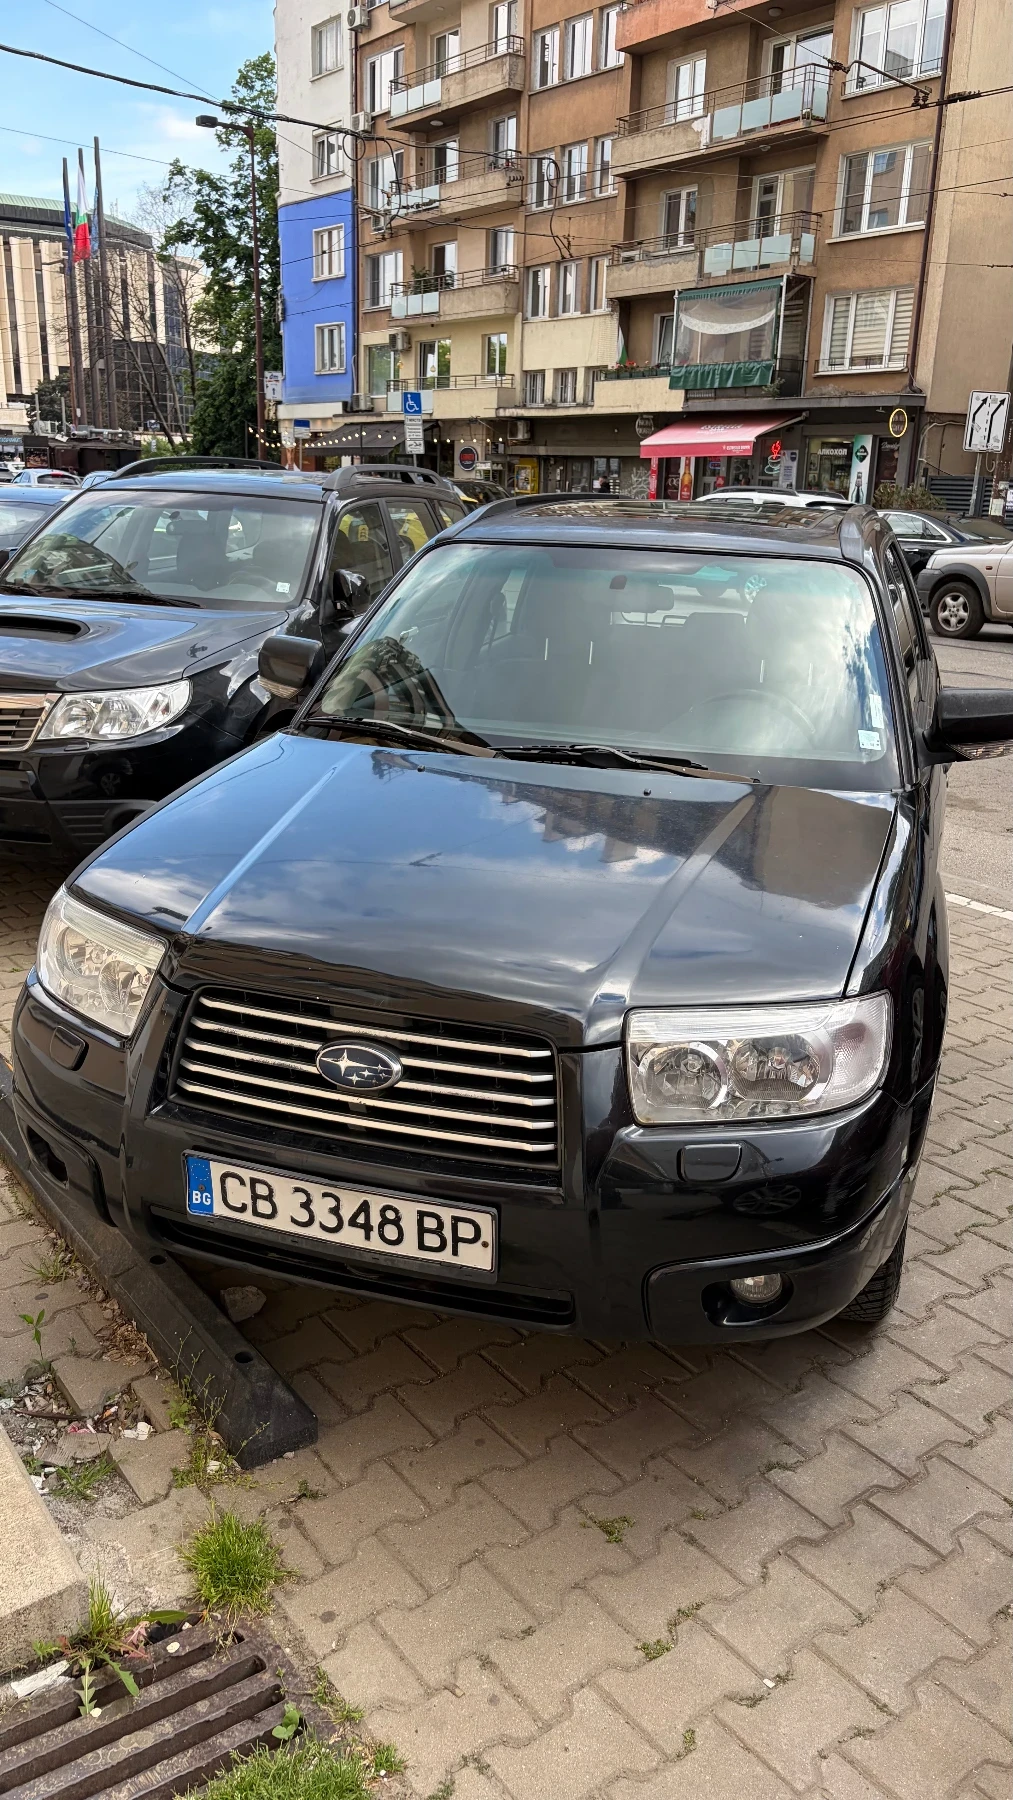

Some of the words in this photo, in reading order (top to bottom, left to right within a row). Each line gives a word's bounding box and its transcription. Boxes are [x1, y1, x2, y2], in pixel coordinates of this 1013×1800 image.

[817, 448, 847, 456] АЛКОХОЛ
[192, 1190, 211, 1206] BG
[219, 1170, 279, 1220] CB
[290, 1186, 405, 1246] 3348
[416, 1209, 481, 1257] BP
